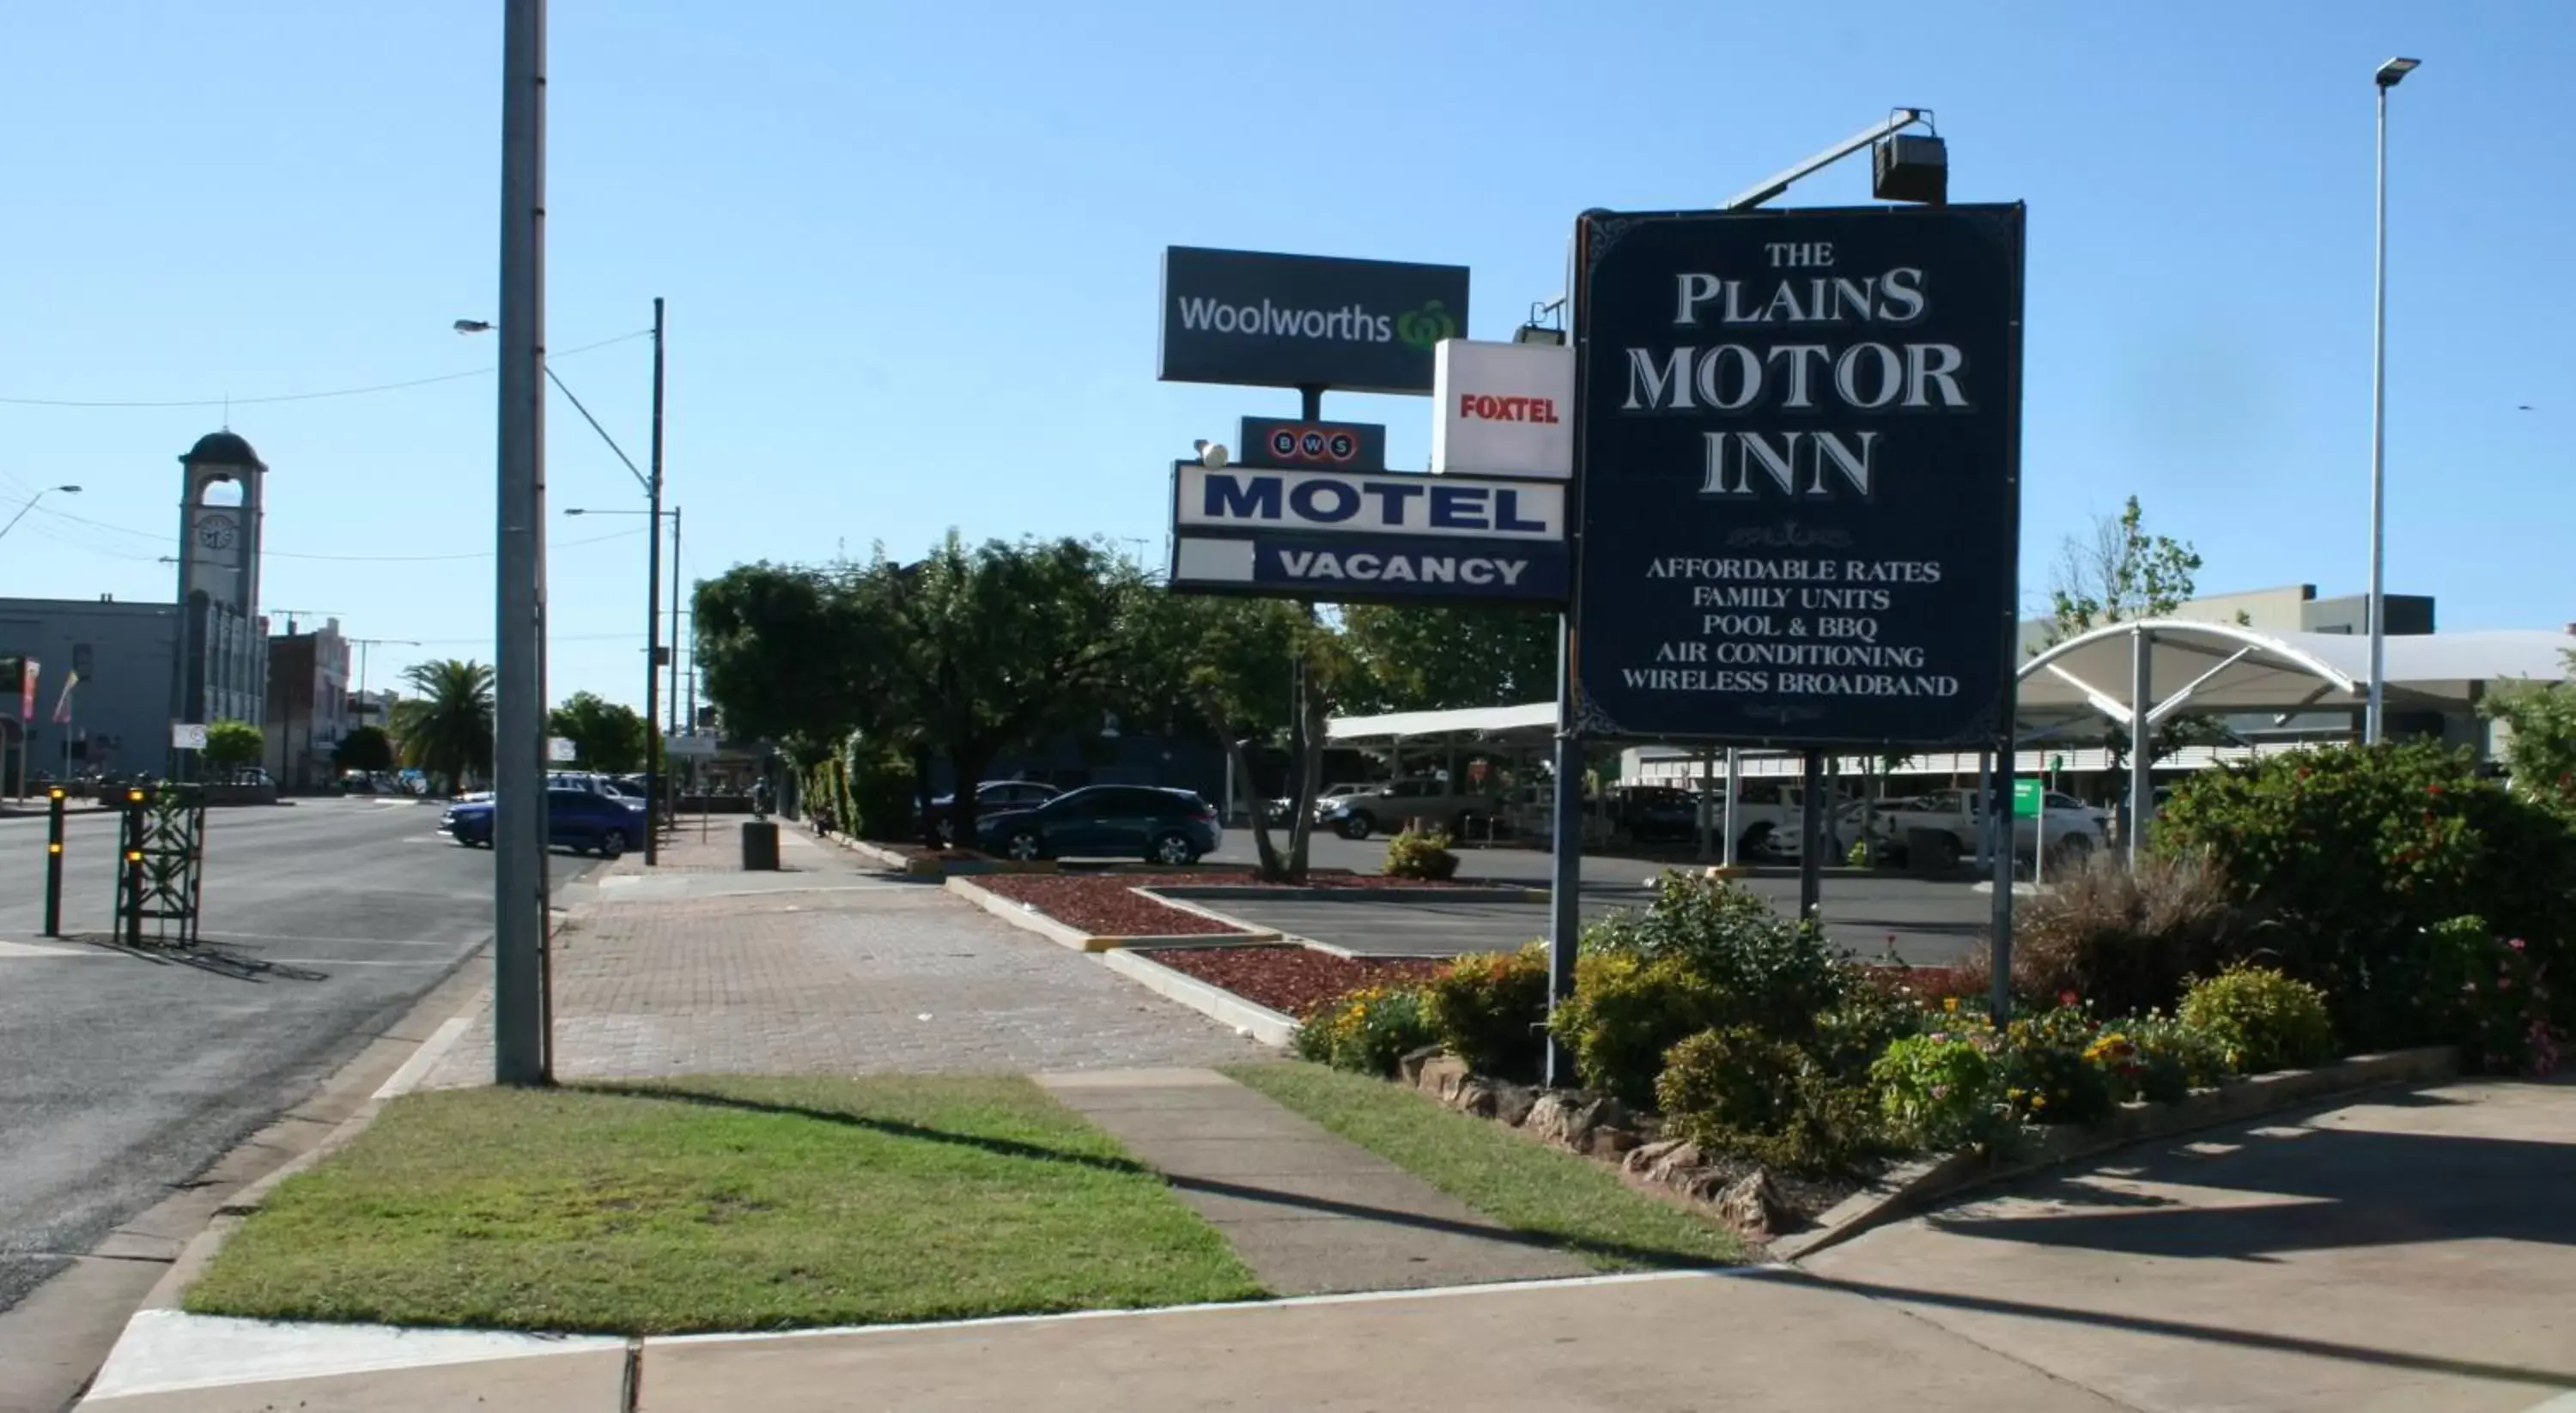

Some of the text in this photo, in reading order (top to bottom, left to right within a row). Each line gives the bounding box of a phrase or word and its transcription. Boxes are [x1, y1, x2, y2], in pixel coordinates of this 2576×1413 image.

[1766, 242, 1834, 266] THE
[1674, 267, 1924, 323] PLAINS
[1180, 296, 1391, 342] Woolworths
[1623, 343, 1969, 409] MOTOR
[1461, 393, 1558, 423] FOXTEL
[1275, 433, 1351, 456] BWS
[1700, 431, 1876, 494] INN
[1205, 474, 1546, 531] MOTEL
[1279, 549, 1528, 585] VACANCY
[1646, 558, 1941, 580] AFFORDABLE RATES
[1692, 585, 1890, 608] FAMILY UNITS
[1704, 615, 1878, 641] POOL & BBQ
[1656, 643, 1924, 667] AIR CONDITIONING
[1623, 670, 1959, 695] WIRELESS BROADBAND
